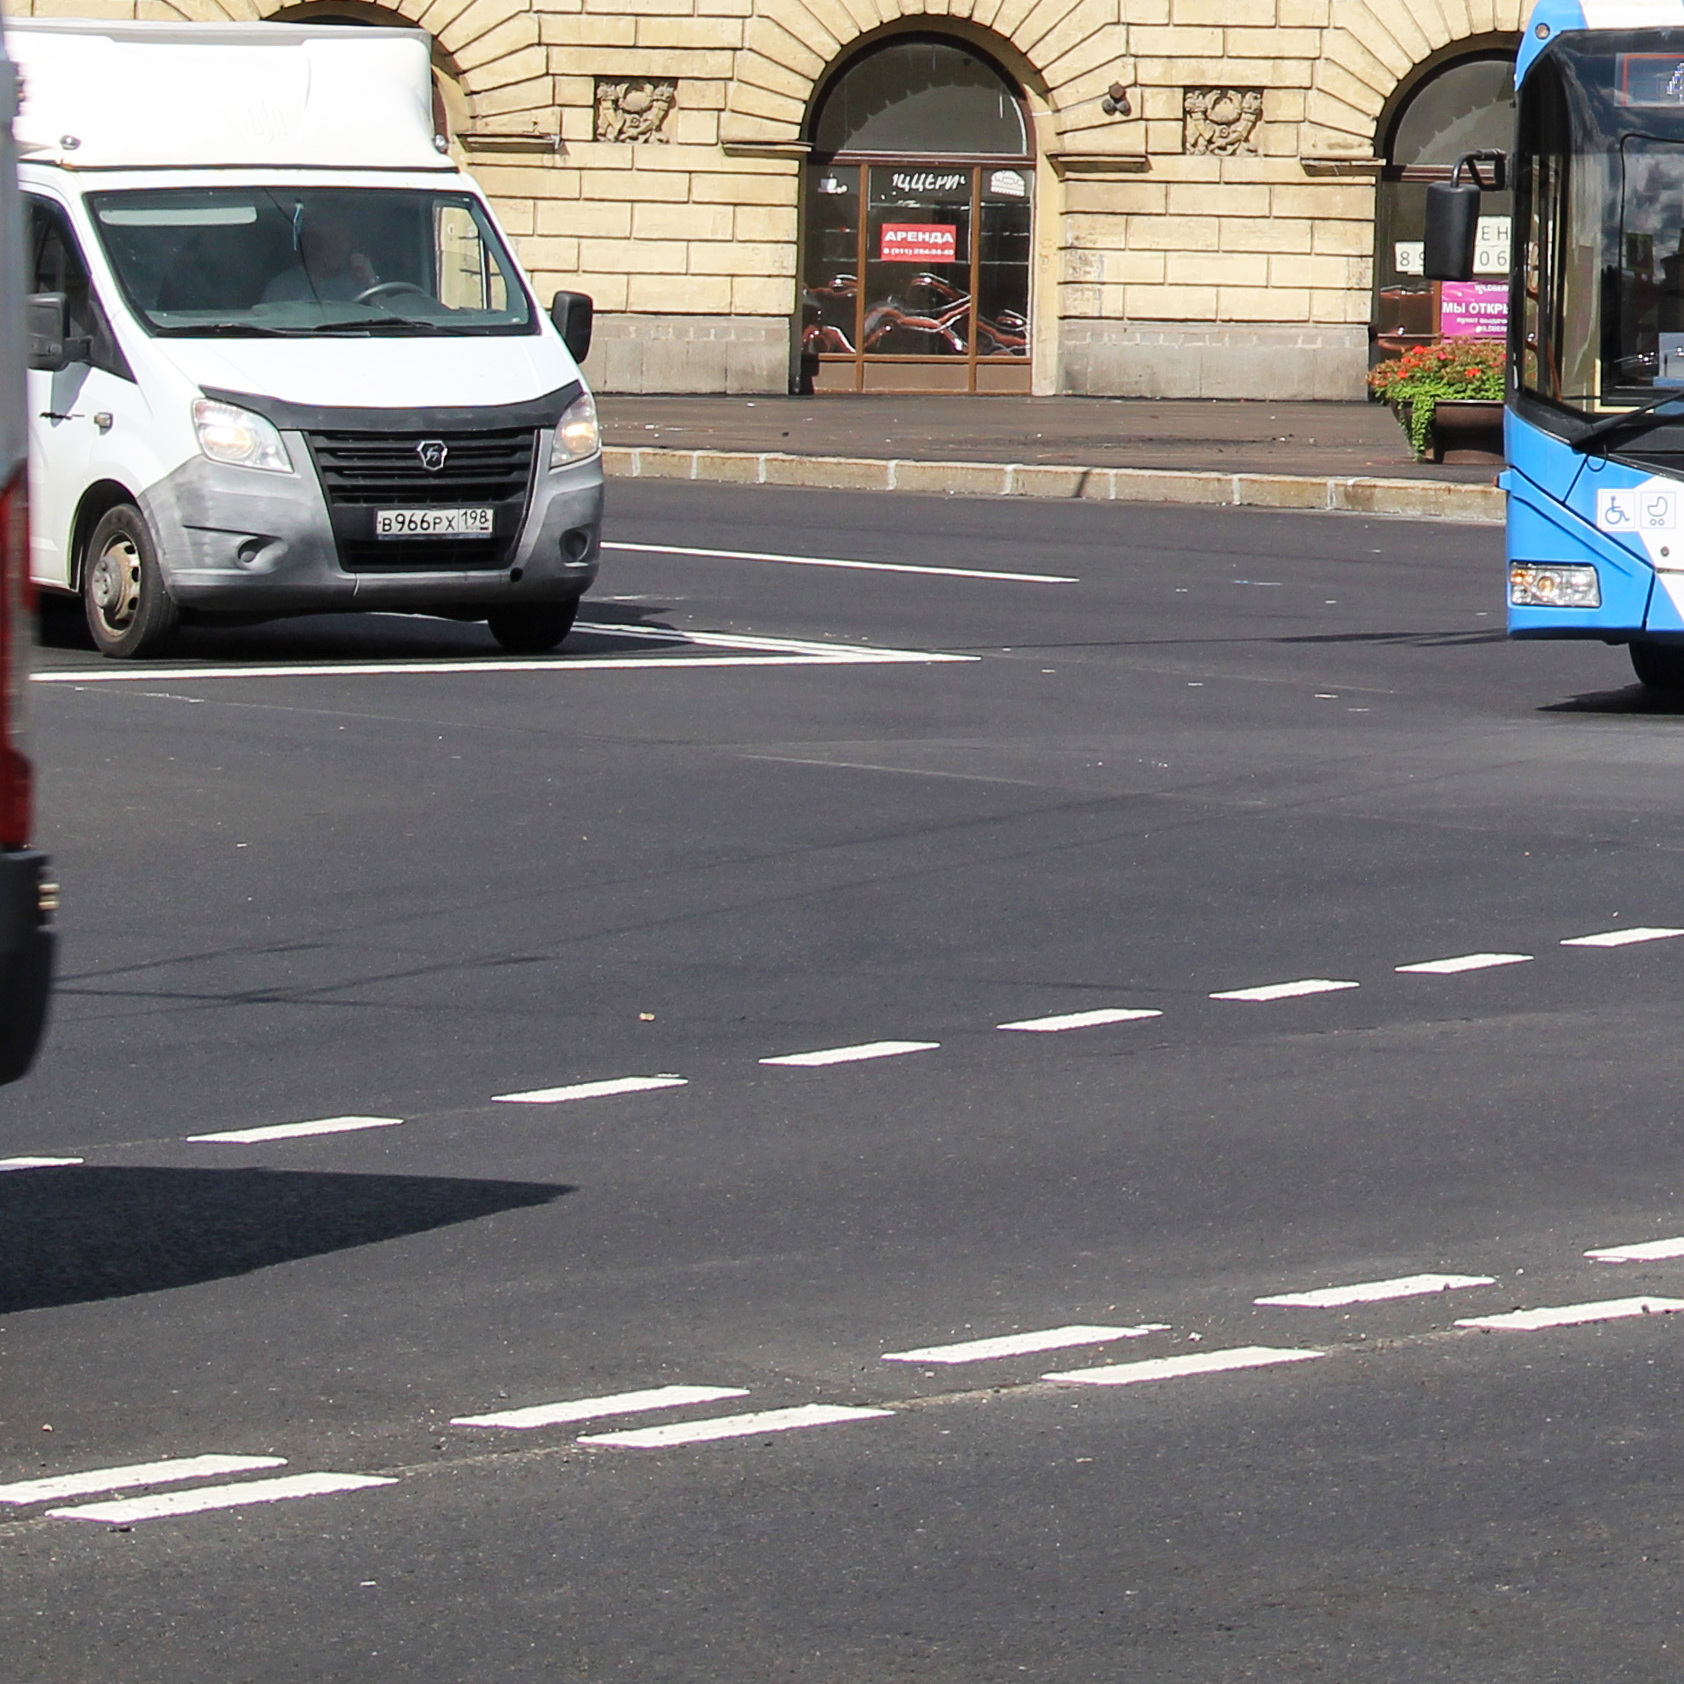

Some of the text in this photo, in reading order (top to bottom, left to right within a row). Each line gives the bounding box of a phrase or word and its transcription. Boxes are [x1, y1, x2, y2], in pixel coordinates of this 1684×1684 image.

[883, 230, 955, 244] АРЕНДА
[1442, 302, 1466, 314] МЫ
[381, 509, 488, 533] В966РХ 198
